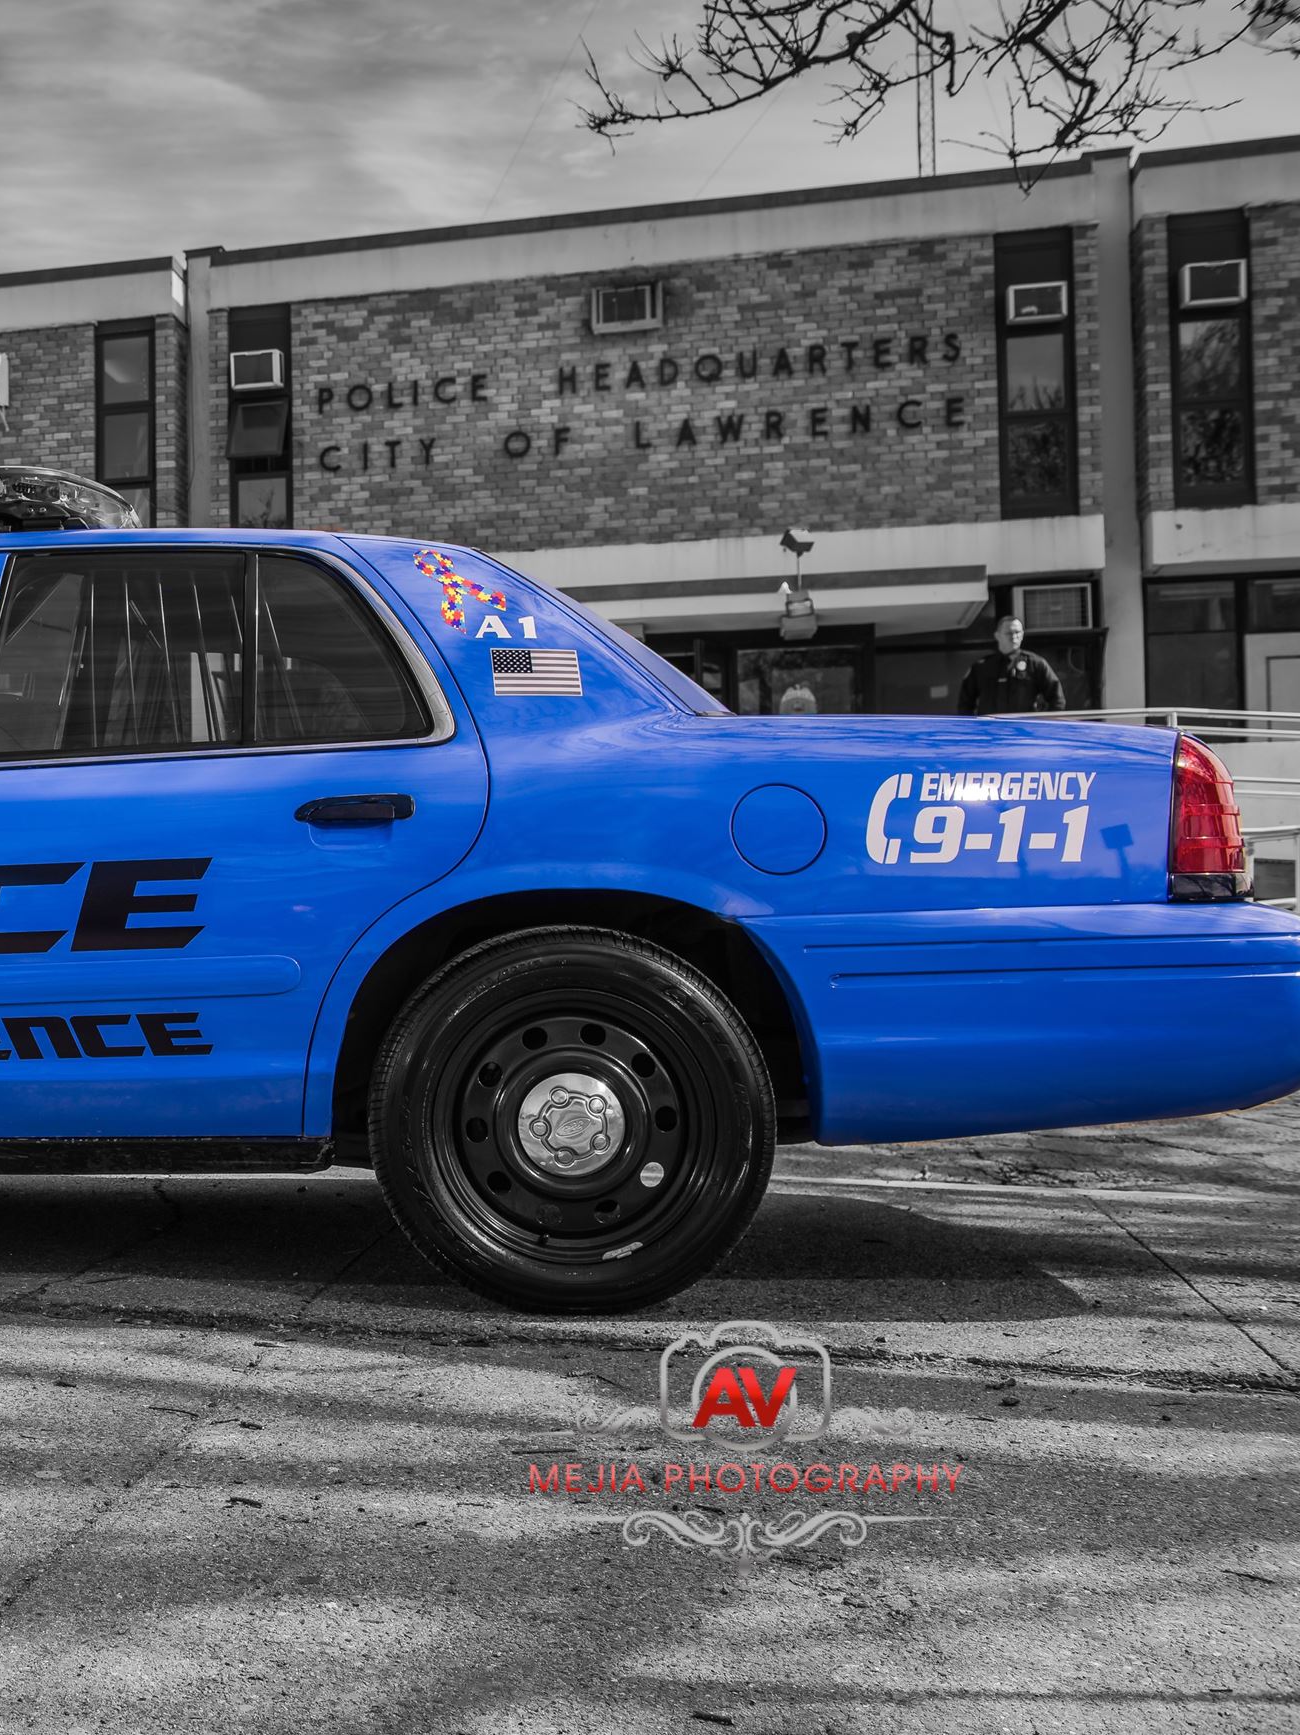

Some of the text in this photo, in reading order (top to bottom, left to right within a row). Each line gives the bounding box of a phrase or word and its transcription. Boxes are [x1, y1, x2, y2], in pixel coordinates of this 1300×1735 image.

[317, 332, 963, 415] POLICE HEADQUARTERS
[319, 397, 965, 472] CITY OF LAWRENCE
[475, 615, 538, 639] A1
[919, 771, 1097, 802] EMERGENCY
[909, 805, 1090, 864] 9-1-1
